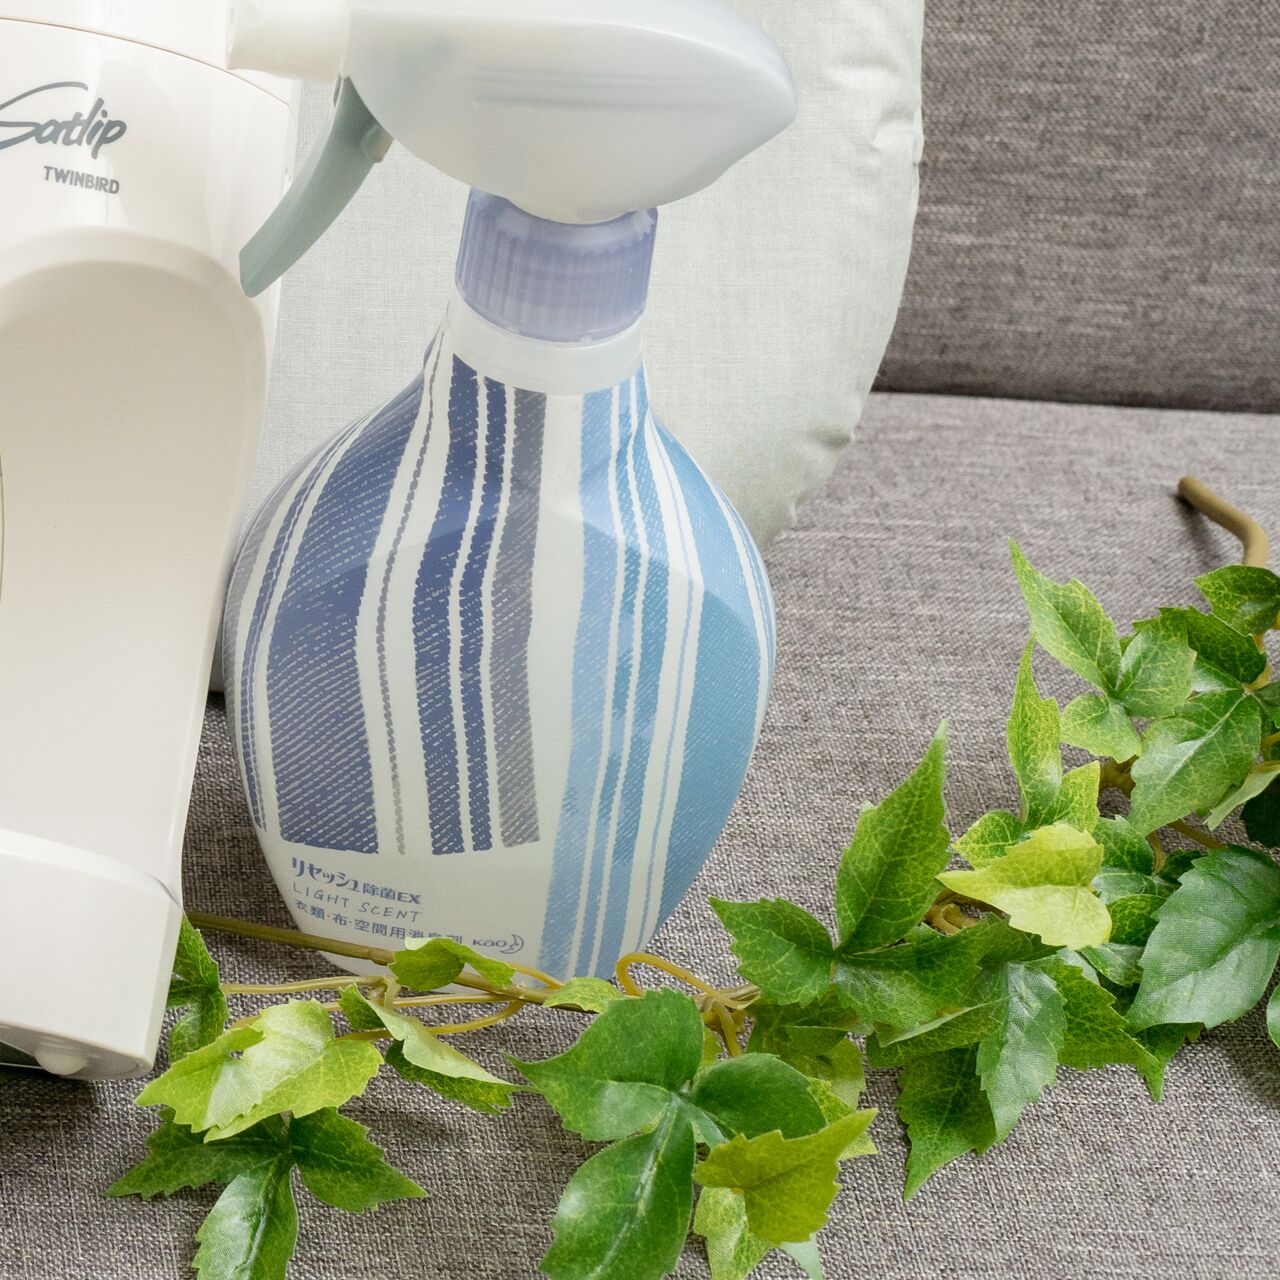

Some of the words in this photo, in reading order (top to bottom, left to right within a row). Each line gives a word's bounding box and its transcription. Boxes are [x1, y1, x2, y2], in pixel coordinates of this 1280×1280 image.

[43, 165, 121, 195] TWINBIRD
[292, 882, 350, 908] LIGHT
[358, 901, 423, 923] SCENT
